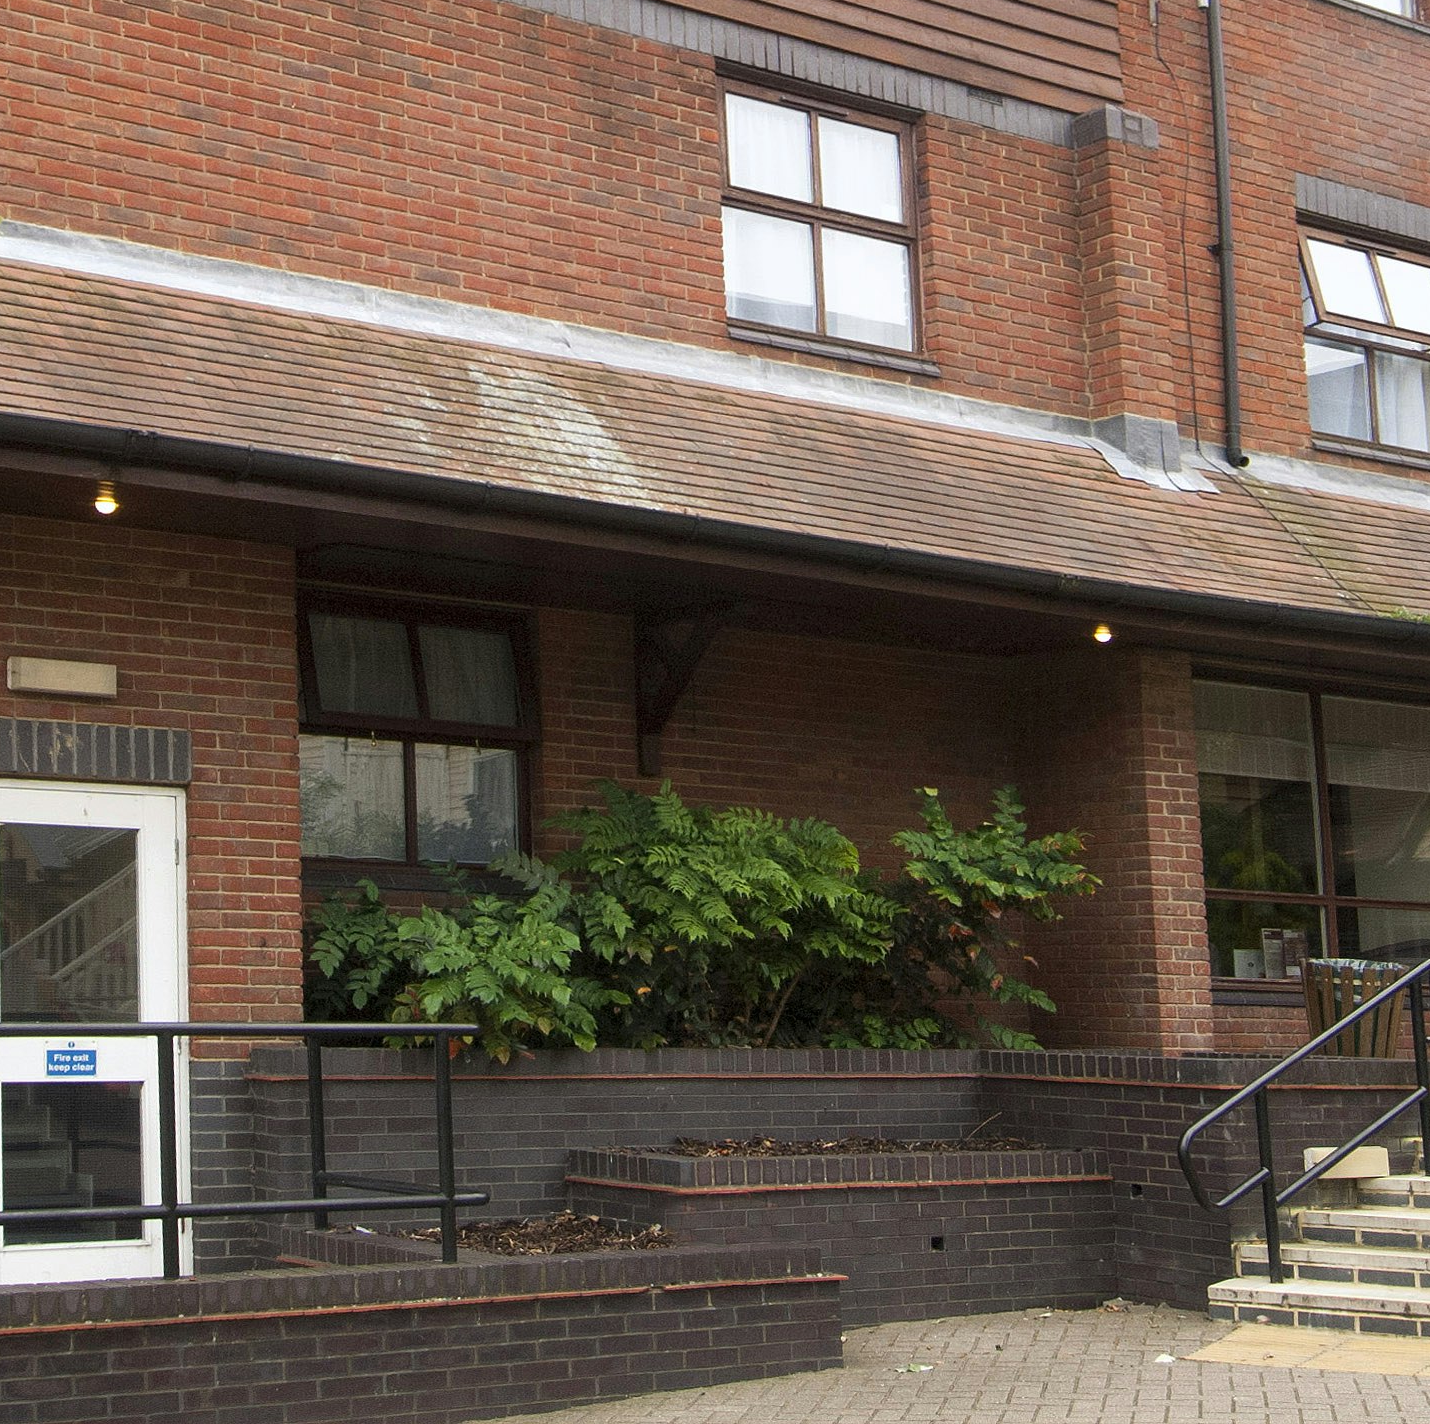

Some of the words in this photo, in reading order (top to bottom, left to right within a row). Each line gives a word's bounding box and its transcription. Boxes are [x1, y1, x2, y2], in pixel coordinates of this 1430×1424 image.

[53, 1054, 71, 1062] Fire
[72, 1054, 89, 1062] exit
[48, 1063, 70, 1073] keep
[71, 1063, 95, 1071] clear
